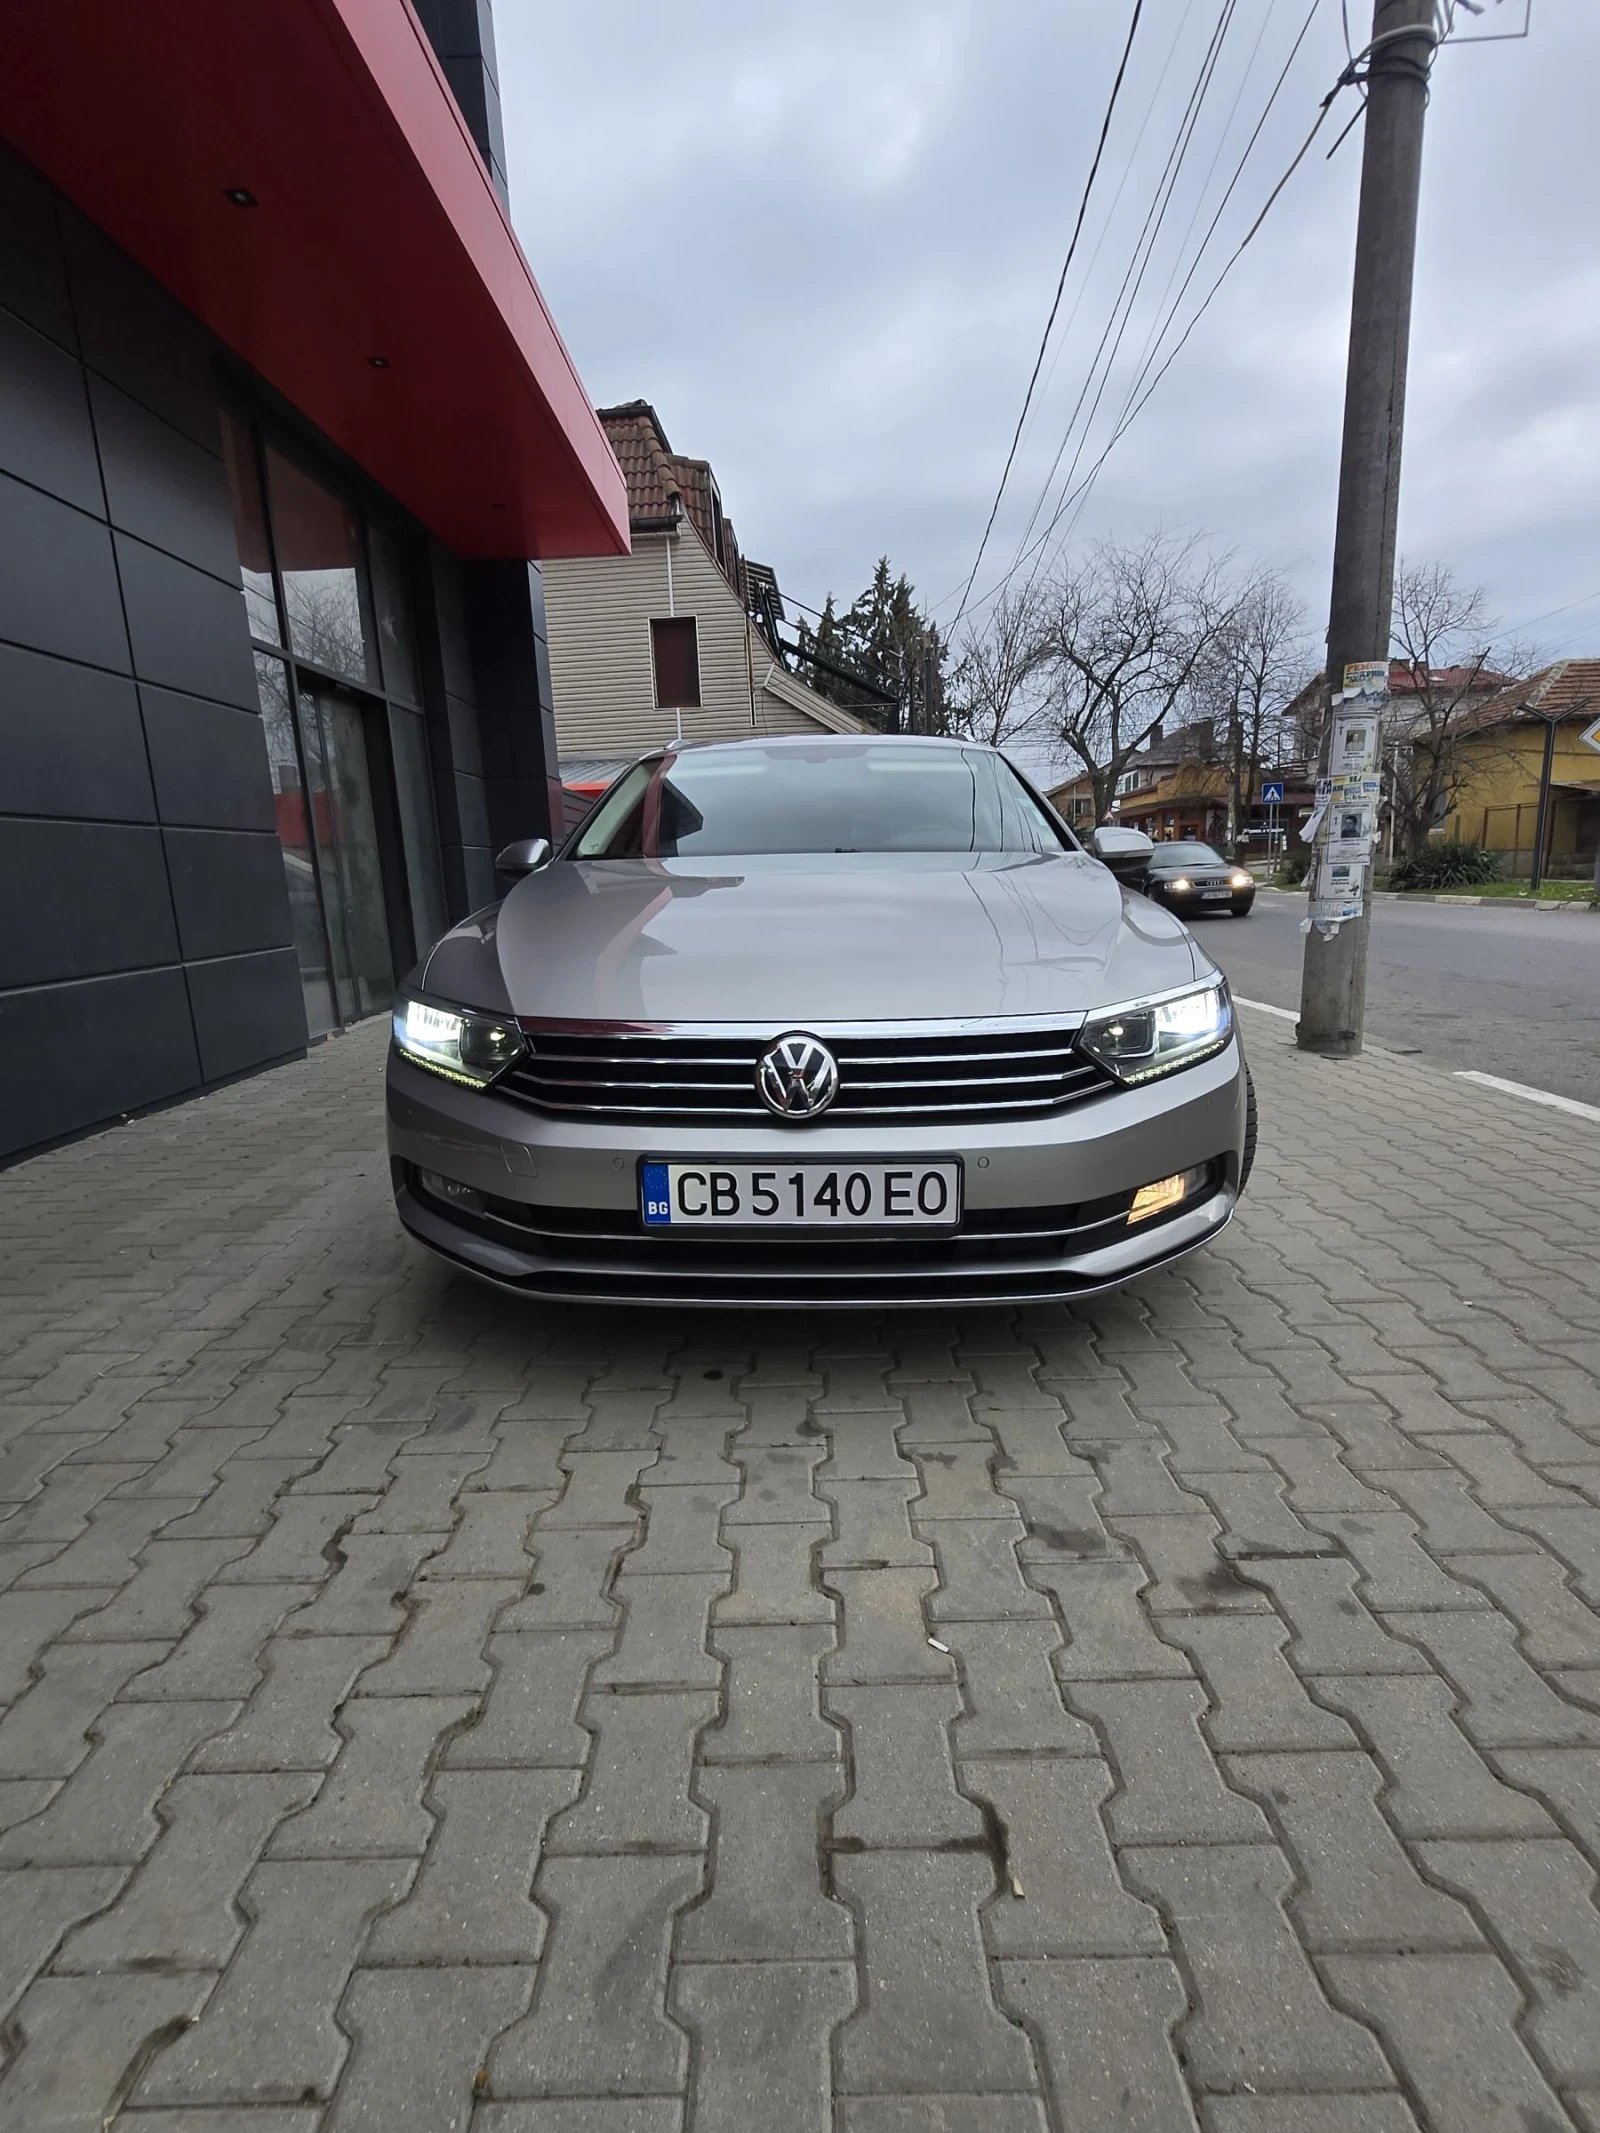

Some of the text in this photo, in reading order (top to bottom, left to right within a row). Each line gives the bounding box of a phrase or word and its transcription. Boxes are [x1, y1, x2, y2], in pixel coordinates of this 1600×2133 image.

[762, 1036, 836, 1115] VW
[648, 1201, 668, 1215] BG
[677, 1171, 741, 1217] CB
[752, 1171, 871, 1217] 5140
